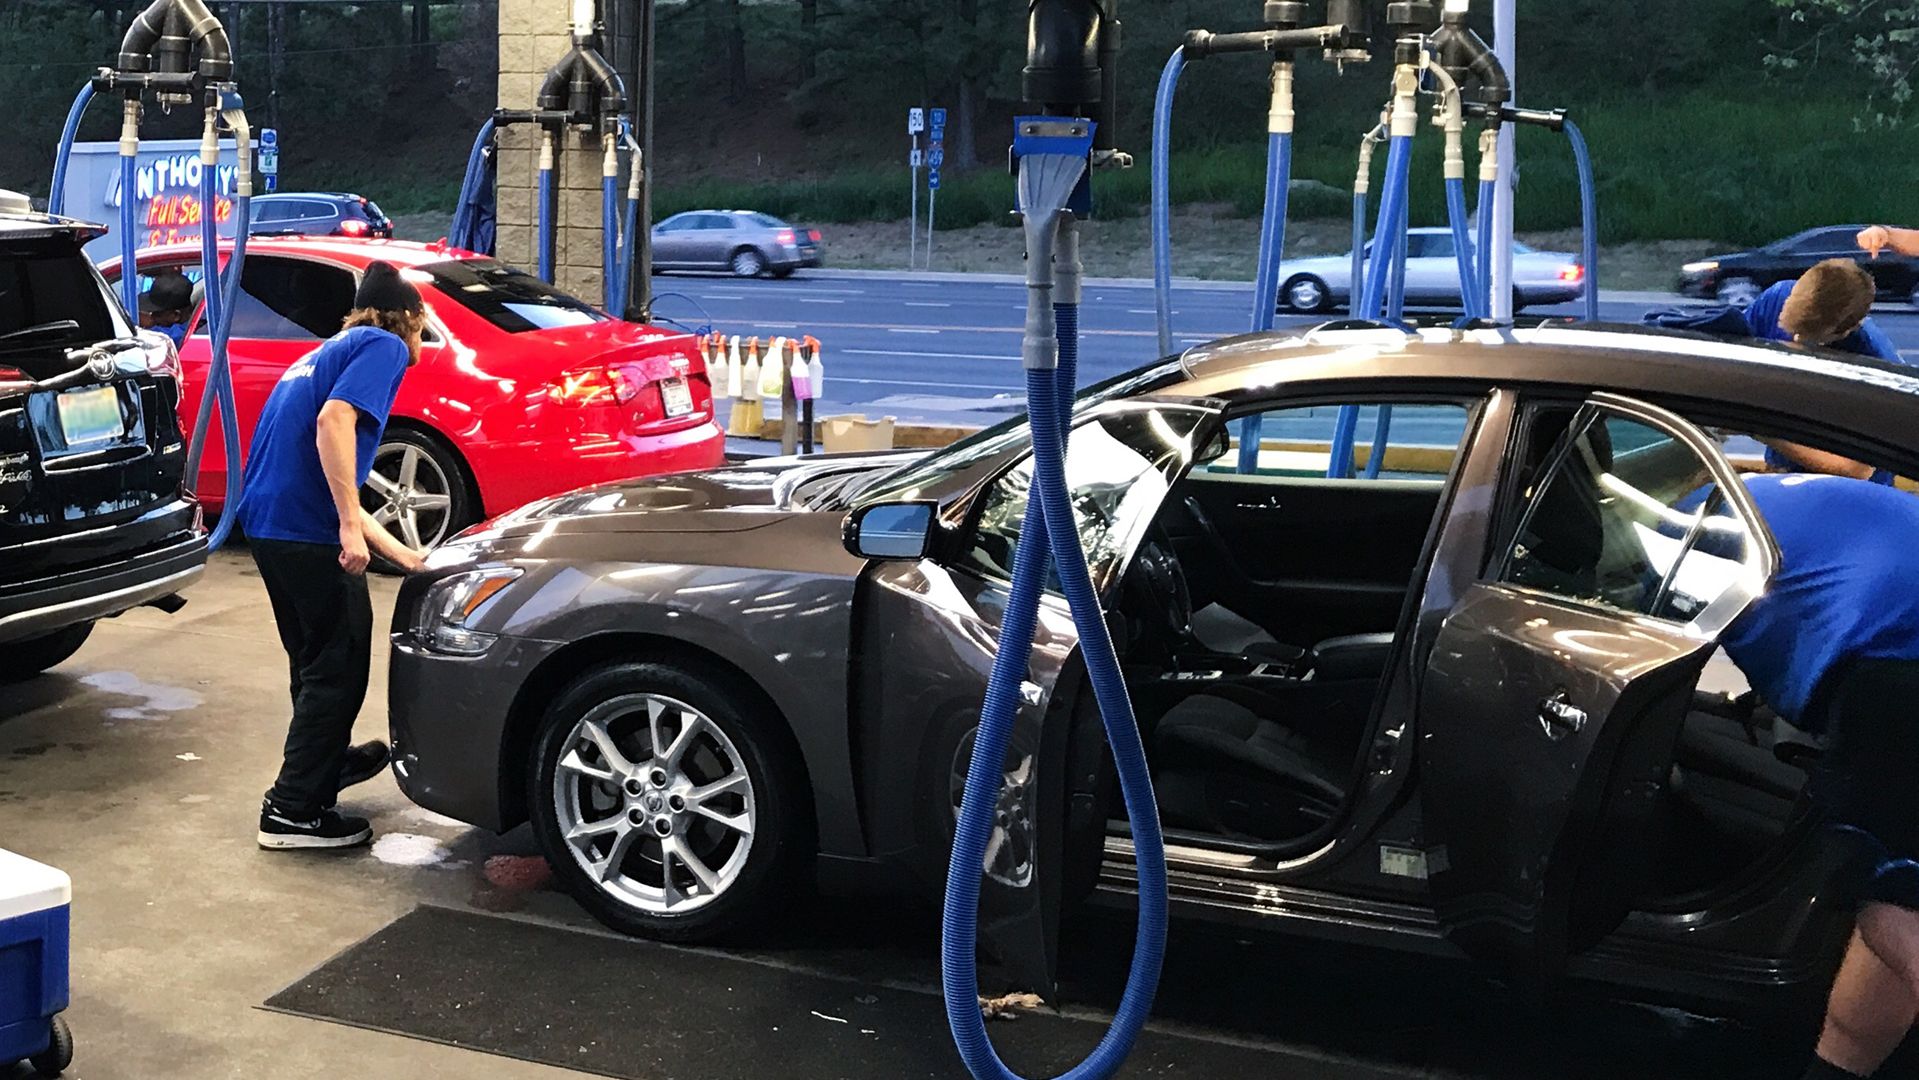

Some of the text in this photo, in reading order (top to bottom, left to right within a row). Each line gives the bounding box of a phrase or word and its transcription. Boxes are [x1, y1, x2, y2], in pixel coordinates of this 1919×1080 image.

[107, 155, 240, 207] NTHOY'
[148, 194, 231, 226] Full Serce
